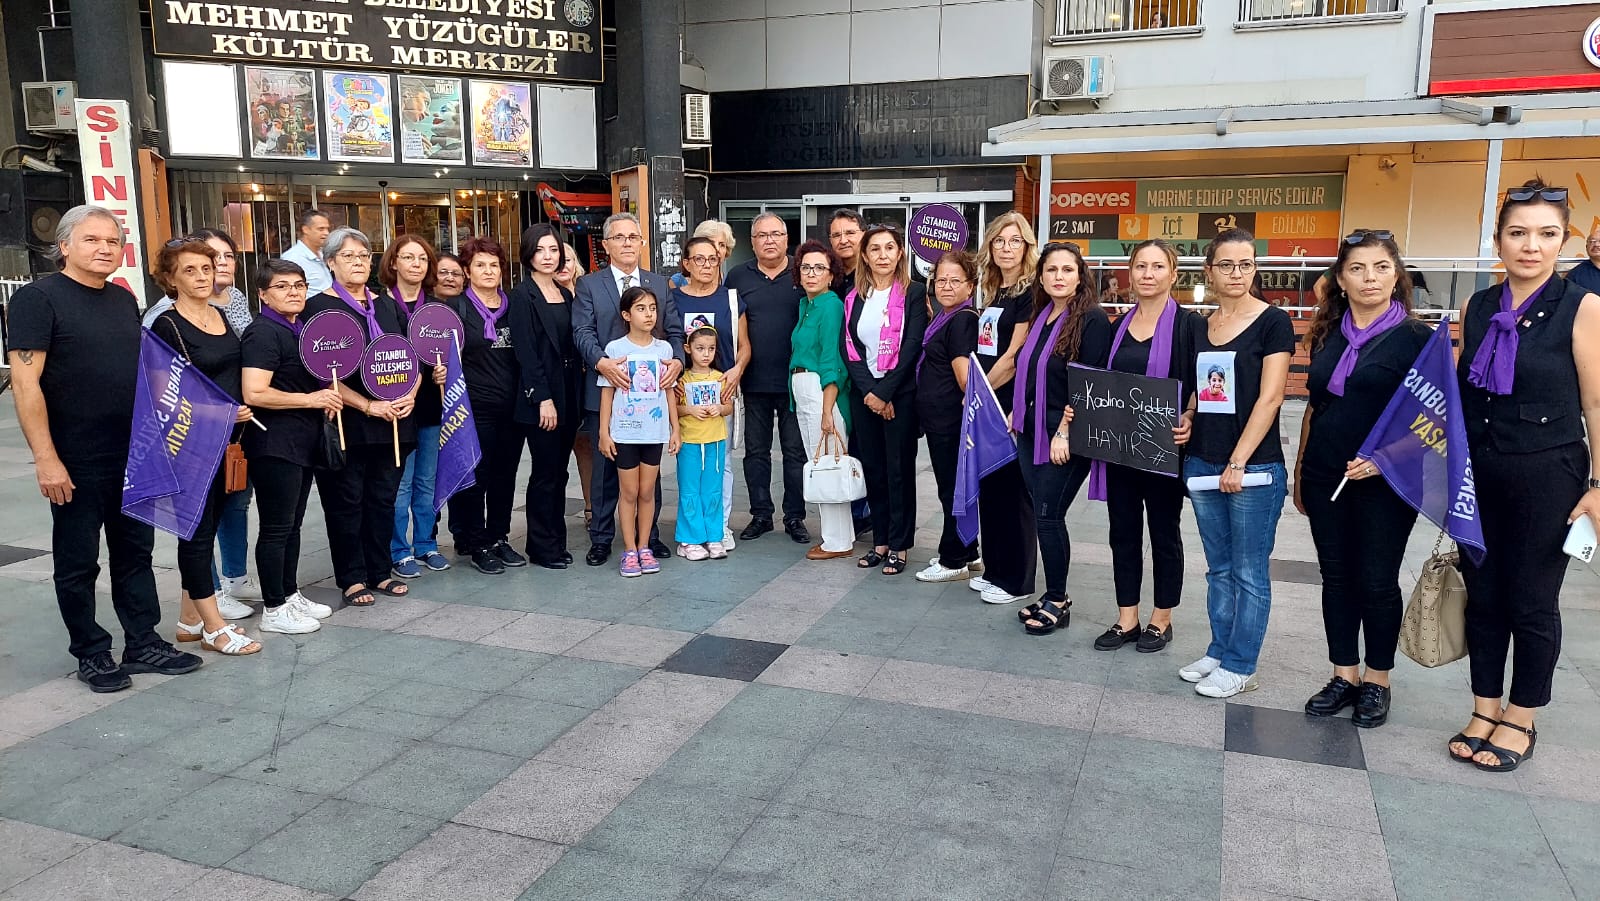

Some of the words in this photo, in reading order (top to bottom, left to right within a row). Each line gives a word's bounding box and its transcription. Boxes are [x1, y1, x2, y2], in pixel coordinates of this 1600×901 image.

[165, 1, 353, 35] MEHMET
[383, 13, 594, 53] YÜZÜGÜLER
[212, 32, 373, 63] KÜLTÜR
[391, 46, 558, 75] MERKEZİ
[922, 213, 958, 231] İSTANBUL
[1052, 220, 1068, 234] 12
[1071, 220, 1096, 234] SAAT
[1161, 215, 1184, 239] İÇİ
[1272, 213, 1316, 236] EDİLMİŞ
[916, 225, 960, 242] SÖZLEŞMESİ
[920, 237, 953, 252] YAŞATIR!
[374, 349, 409, 362] İSTANBUL
[370, 359, 413, 375] SÖZLEŞMESİ
[376, 373, 409, 387] YAŞATIR!
[1088, 424, 1146, 459] HAYIR
